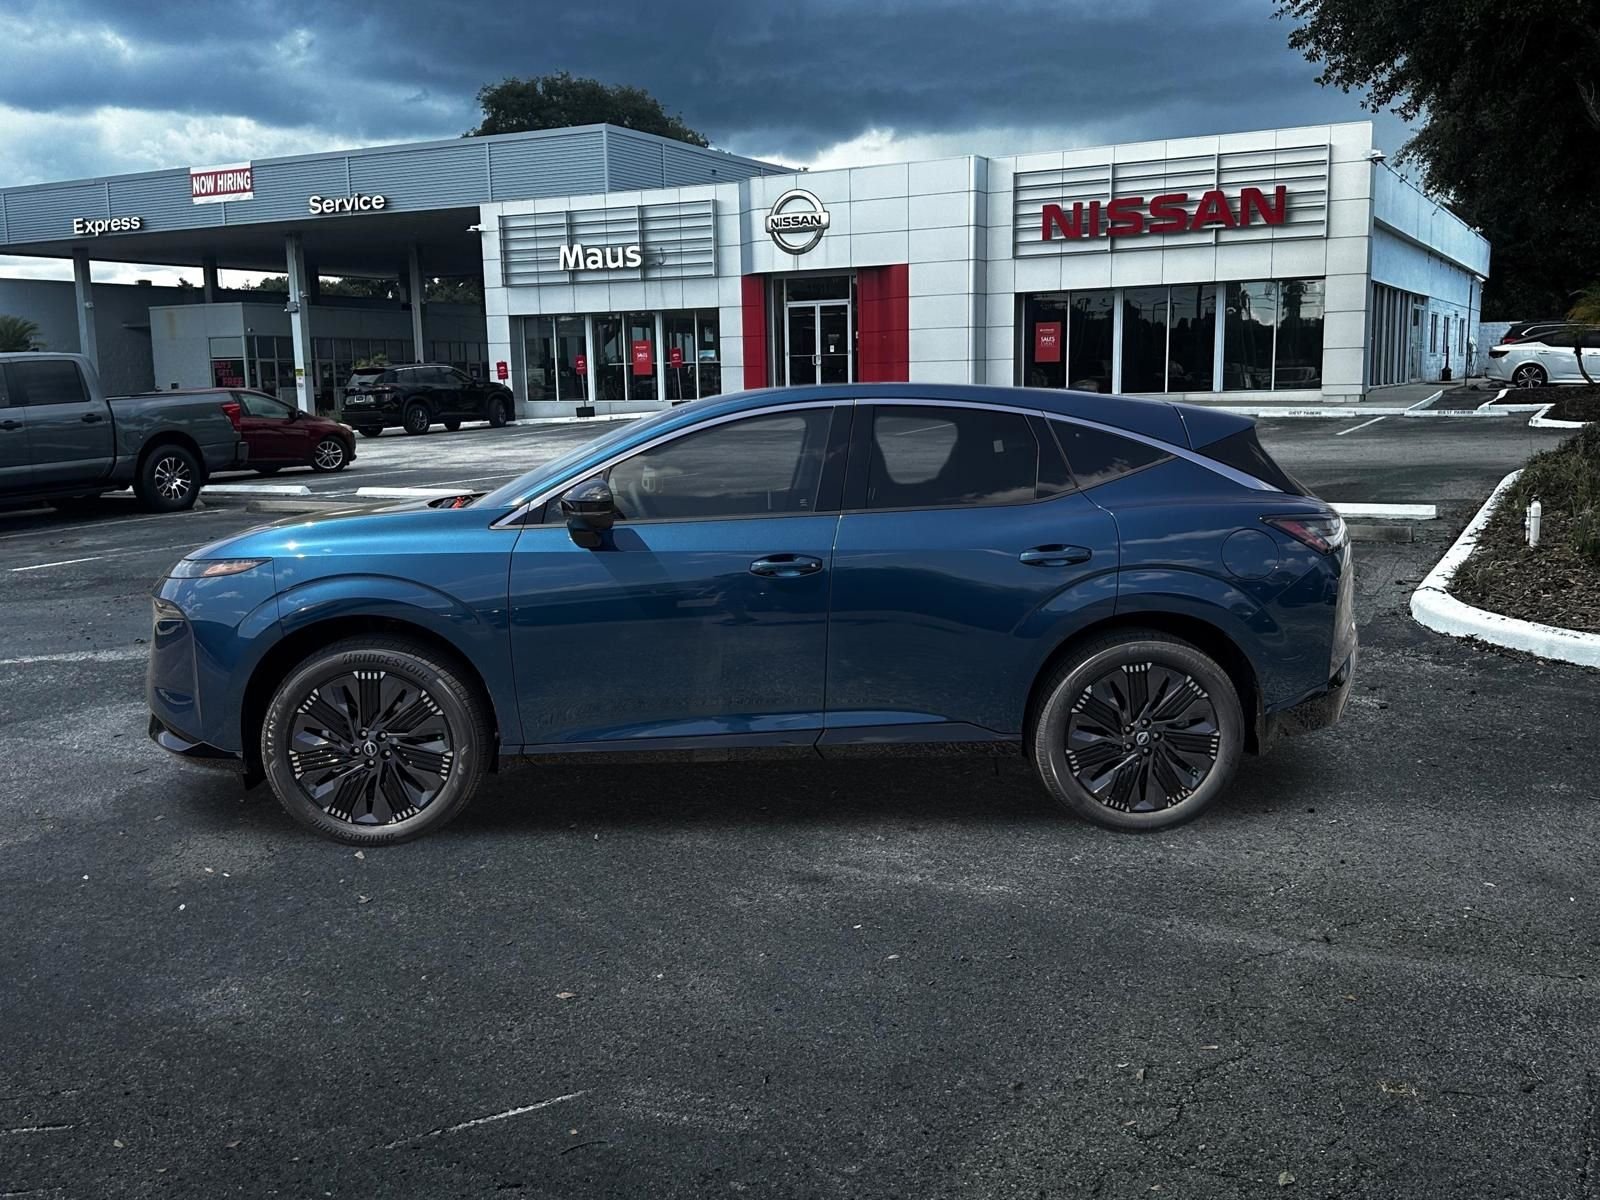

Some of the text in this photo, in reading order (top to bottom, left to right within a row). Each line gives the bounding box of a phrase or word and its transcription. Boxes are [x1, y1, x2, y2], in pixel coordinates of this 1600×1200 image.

[192, 171, 251, 194] NOW HIRING
[308, 193, 385, 214] Service
[1041, 185, 1287, 241] NISSAN
[73, 217, 142, 236] Express
[770, 215, 822, 228] NISSAN
[559, 243, 642, 270] Maus
[342, 653, 430, 681] BRIDGESTONE
